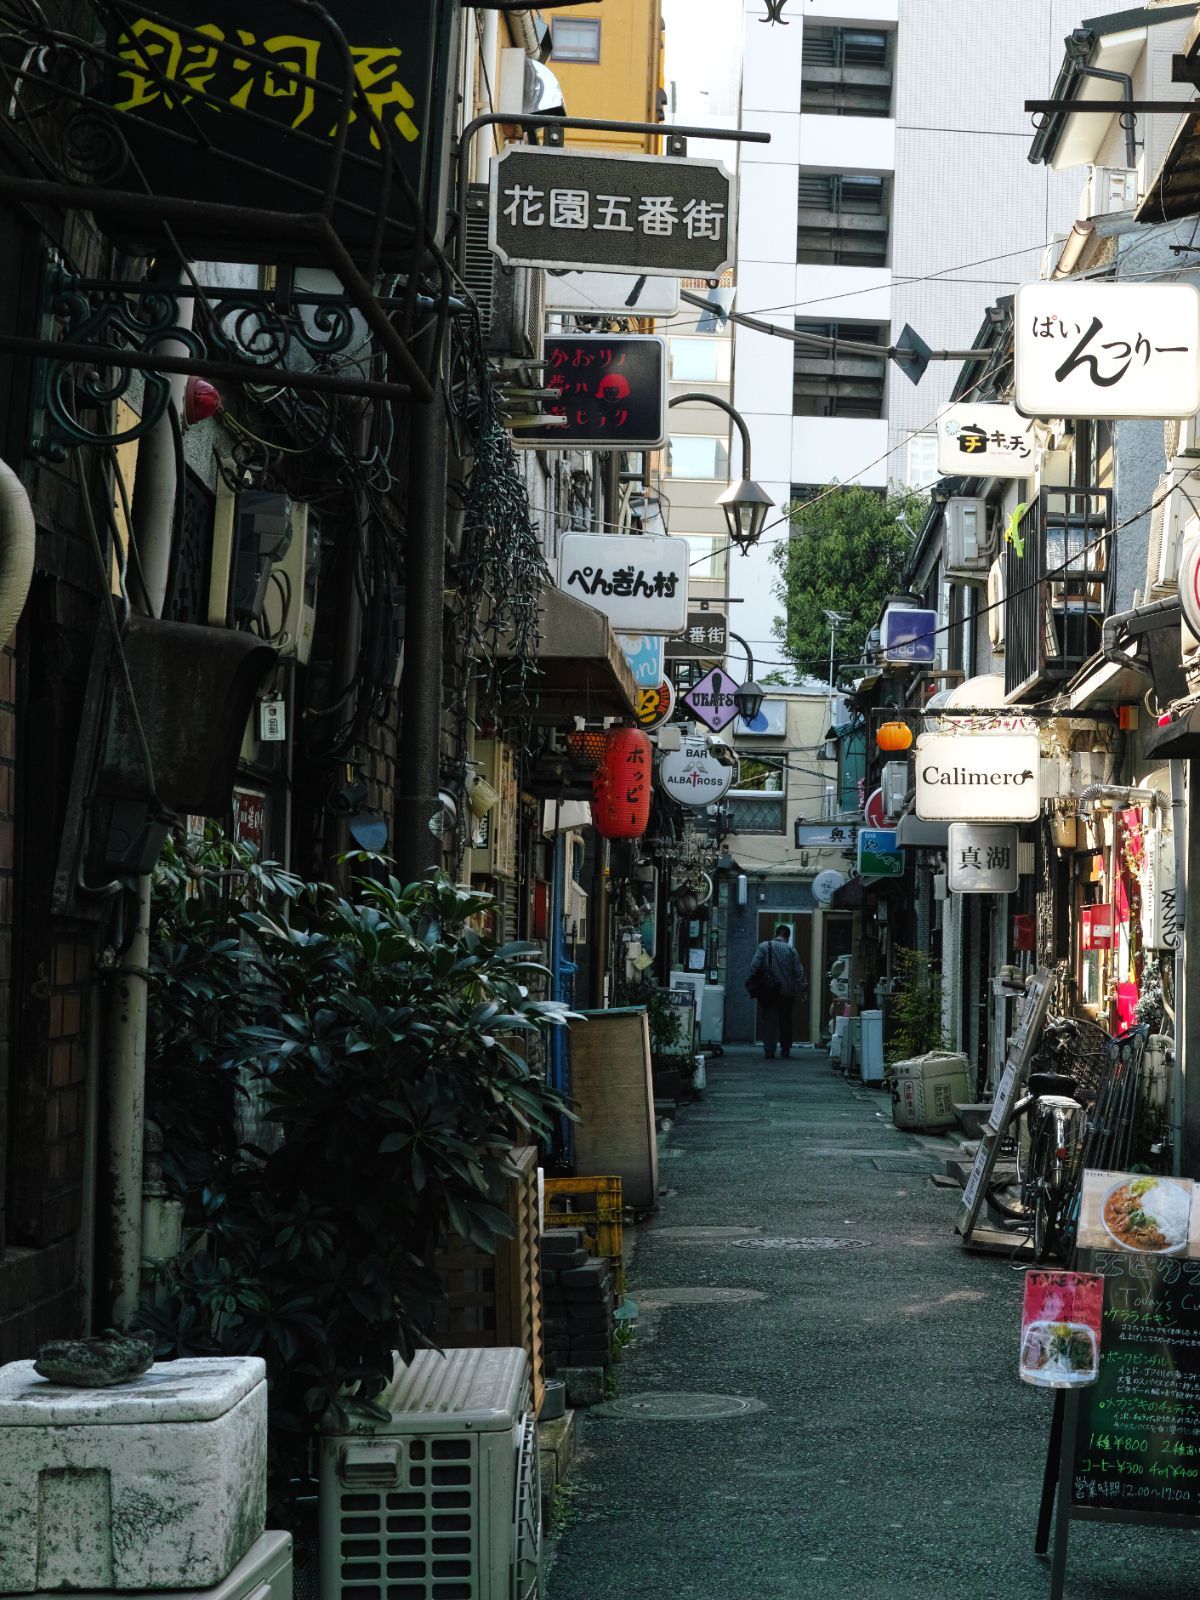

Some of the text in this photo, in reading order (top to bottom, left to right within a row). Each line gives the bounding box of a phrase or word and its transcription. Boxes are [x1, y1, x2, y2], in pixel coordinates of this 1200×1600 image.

[503, 184, 725, 241] 花園五番街
[990, 429, 1032, 459] キッチン
[567, 565, 679, 599] ぺんぎん村
[686, 749, 708, 759] BAR
[626, 744, 646, 825] ホッピー
[667, 772, 723, 788] ALBATROSS
[922, 765, 1026, 786] Calimero
[957, 845, 1011, 871] 真湖
[1118, 1286, 1172, 1313] Today's
